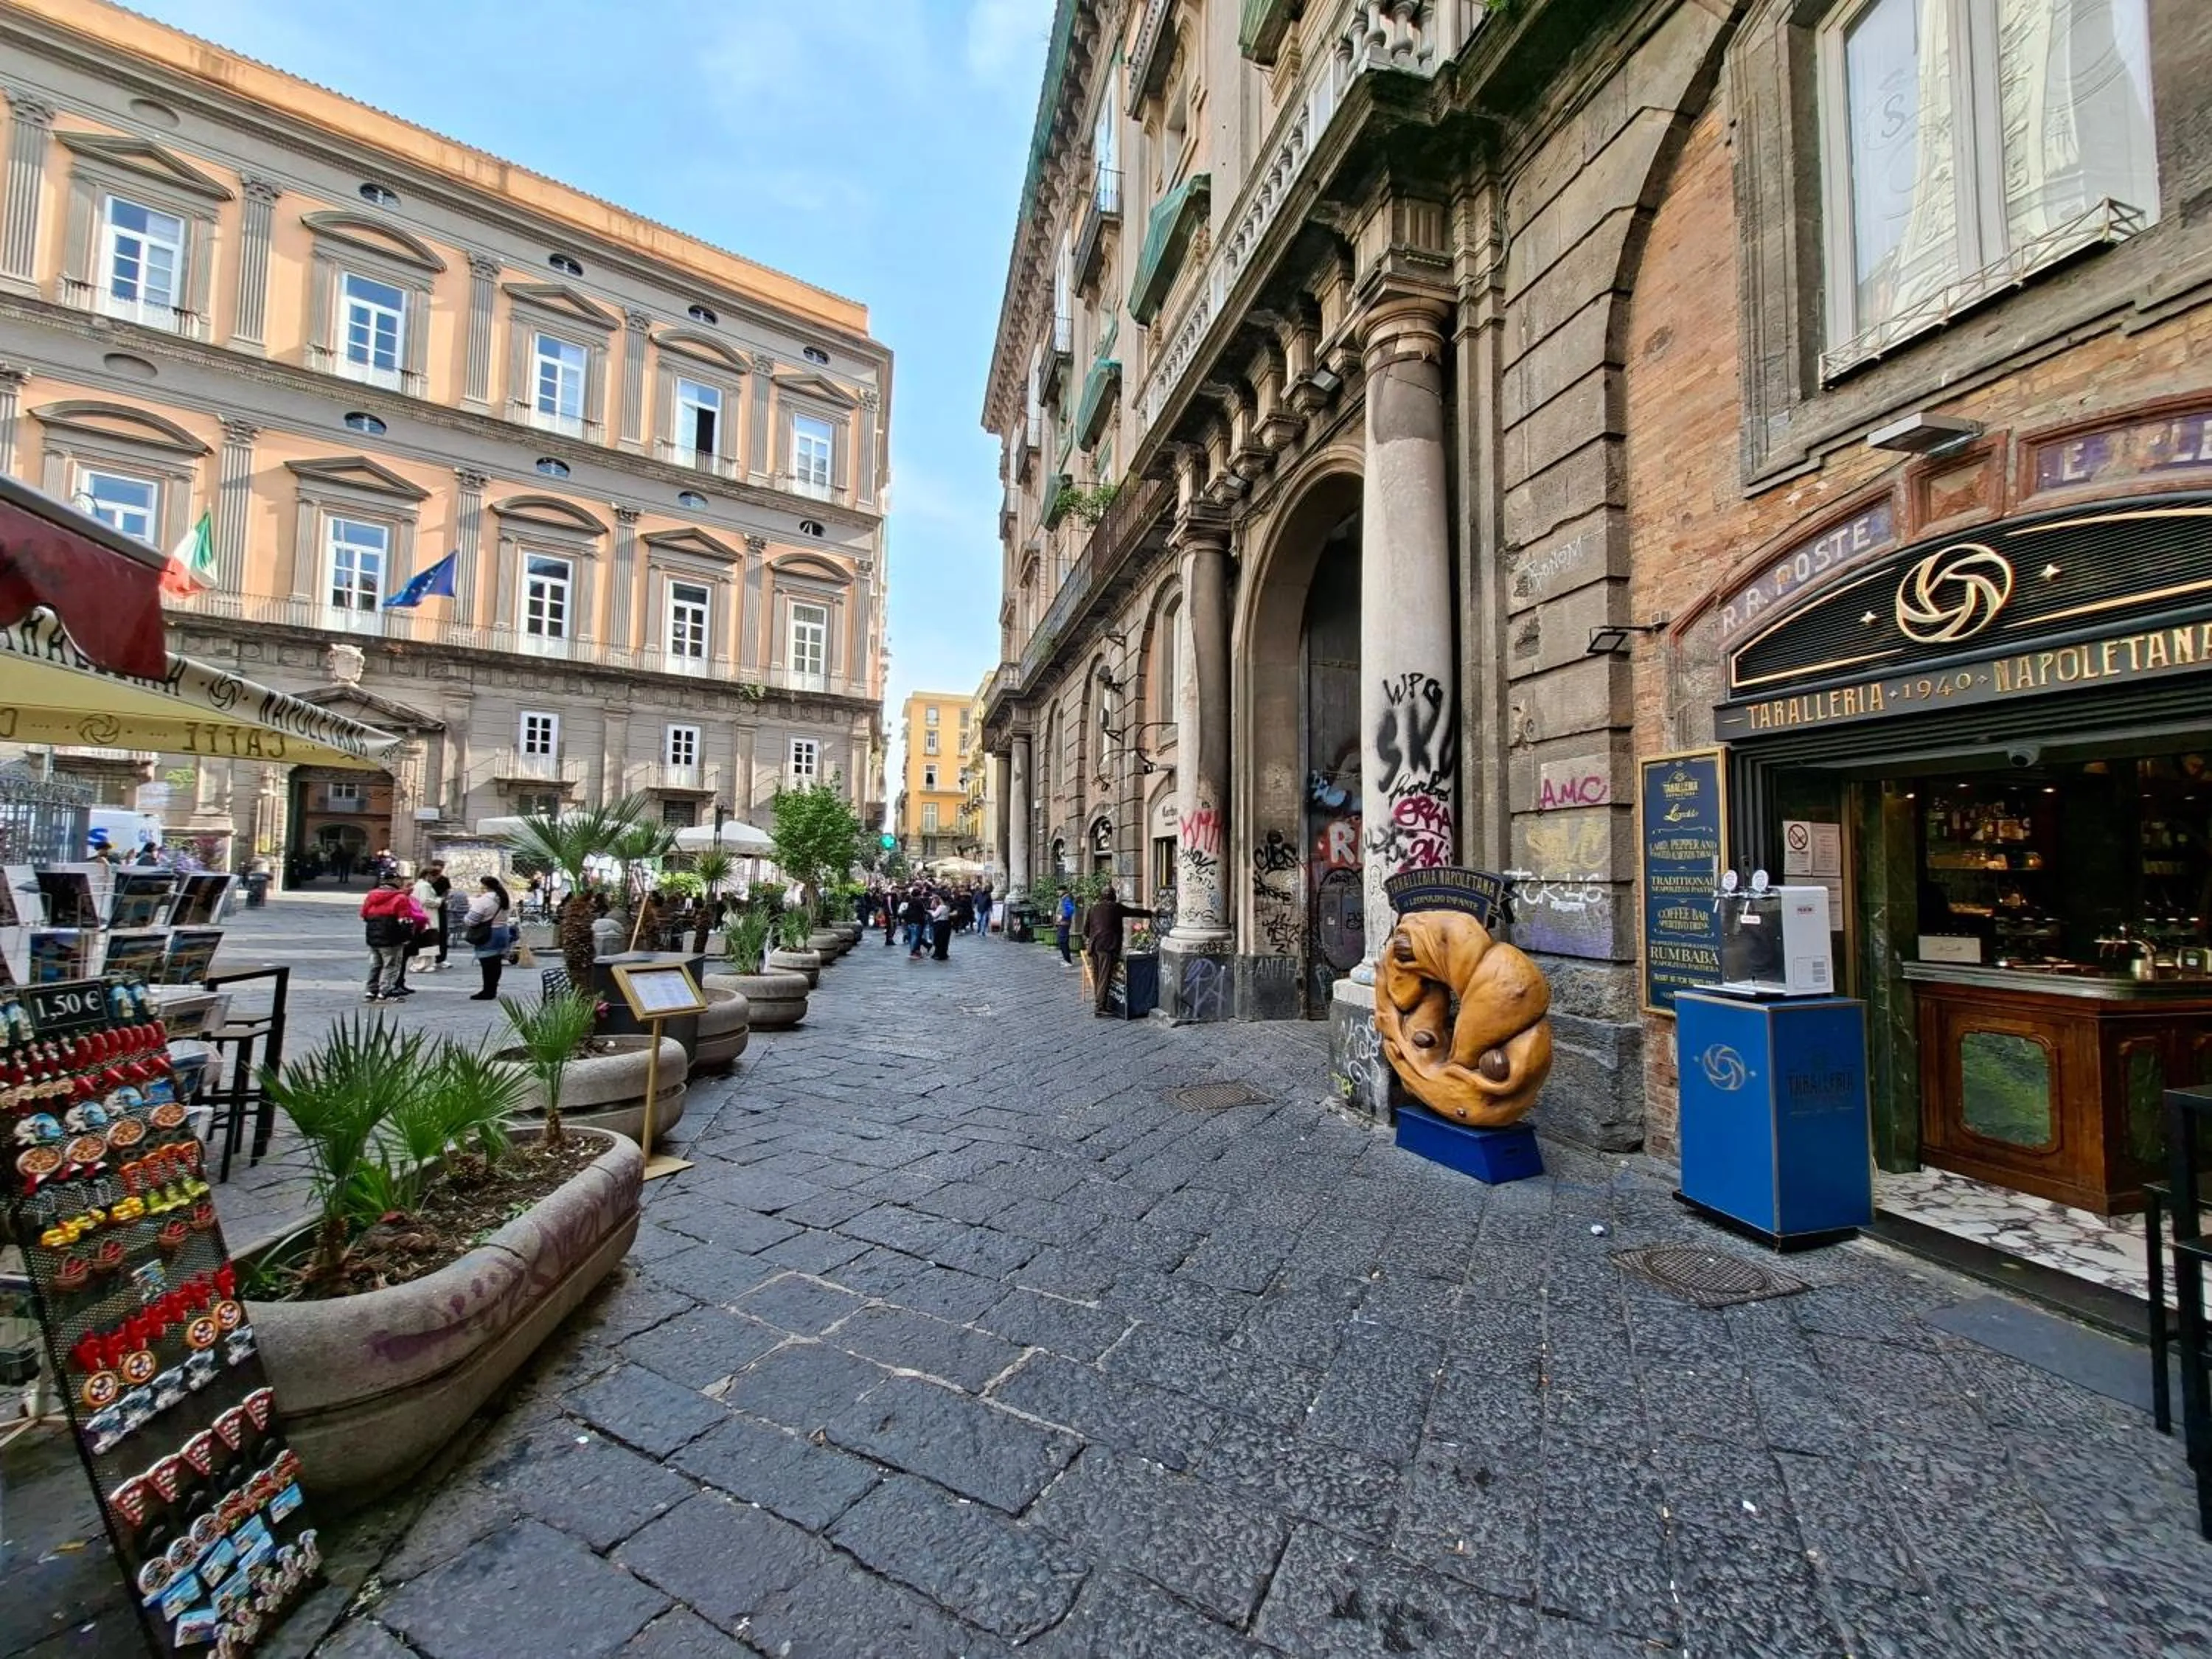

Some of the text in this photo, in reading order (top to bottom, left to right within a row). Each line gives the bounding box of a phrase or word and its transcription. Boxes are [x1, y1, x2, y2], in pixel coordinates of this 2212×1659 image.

[1775, 517, 1871, 596] POSTE
[1747, 681, 1886, 730] TARALLERIA
[1902, 672, 1972, 700] 1940
[1540, 776, 1607, 808] AMC
[1438, 868, 1496, 897] NAPOLETANA
[1657, 907, 1710, 921] COFFEE BAR
[36, 990, 102, 1020] 1,50 €
